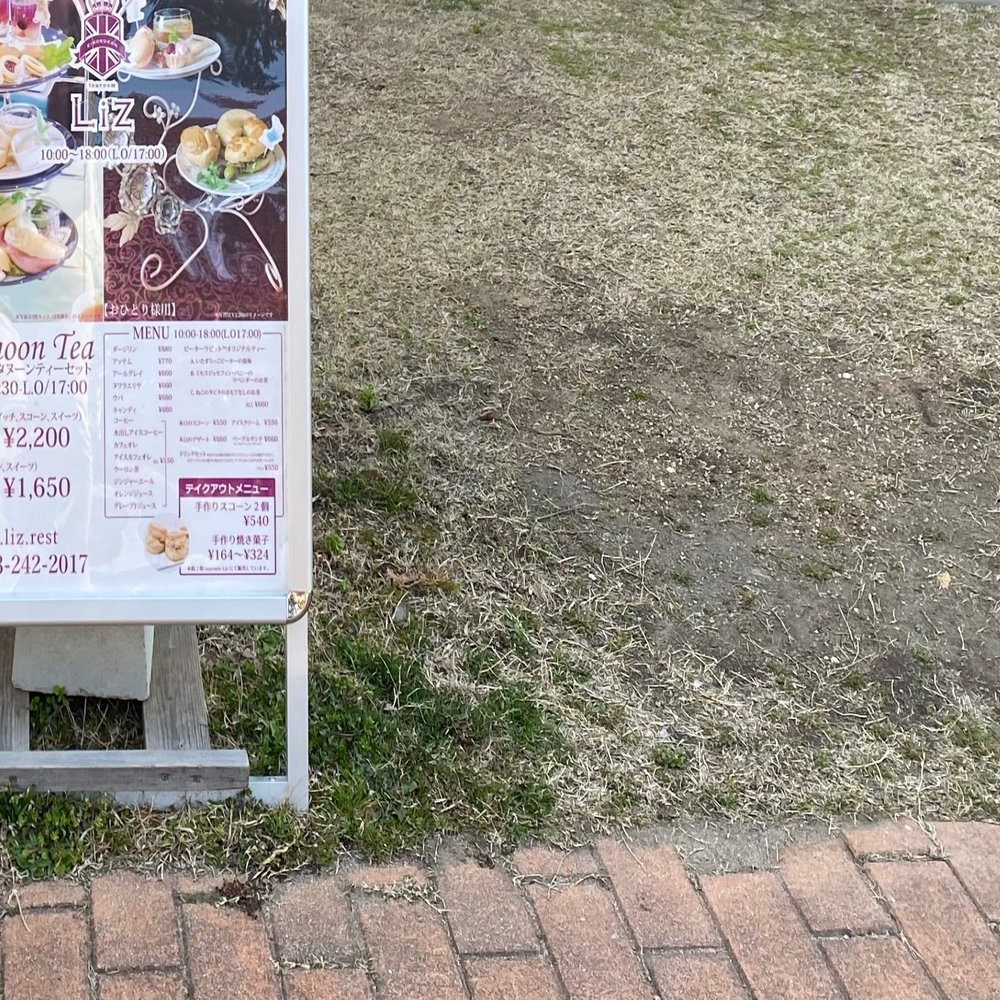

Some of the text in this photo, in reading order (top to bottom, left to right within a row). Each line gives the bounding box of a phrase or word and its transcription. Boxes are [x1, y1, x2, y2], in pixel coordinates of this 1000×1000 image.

[133, 325, 170, 340] MENU
[53, 330, 95, 360] Tea
[3, 426, 71, 450] ¥2,200
[3, 476, 71, 500] ¥1,650
[185, 483, 269, 495] テイクアウトメニュー
[243, 515, 269, 526] ¥540
[212, 534, 270, 546] 手作り焼き菓子
